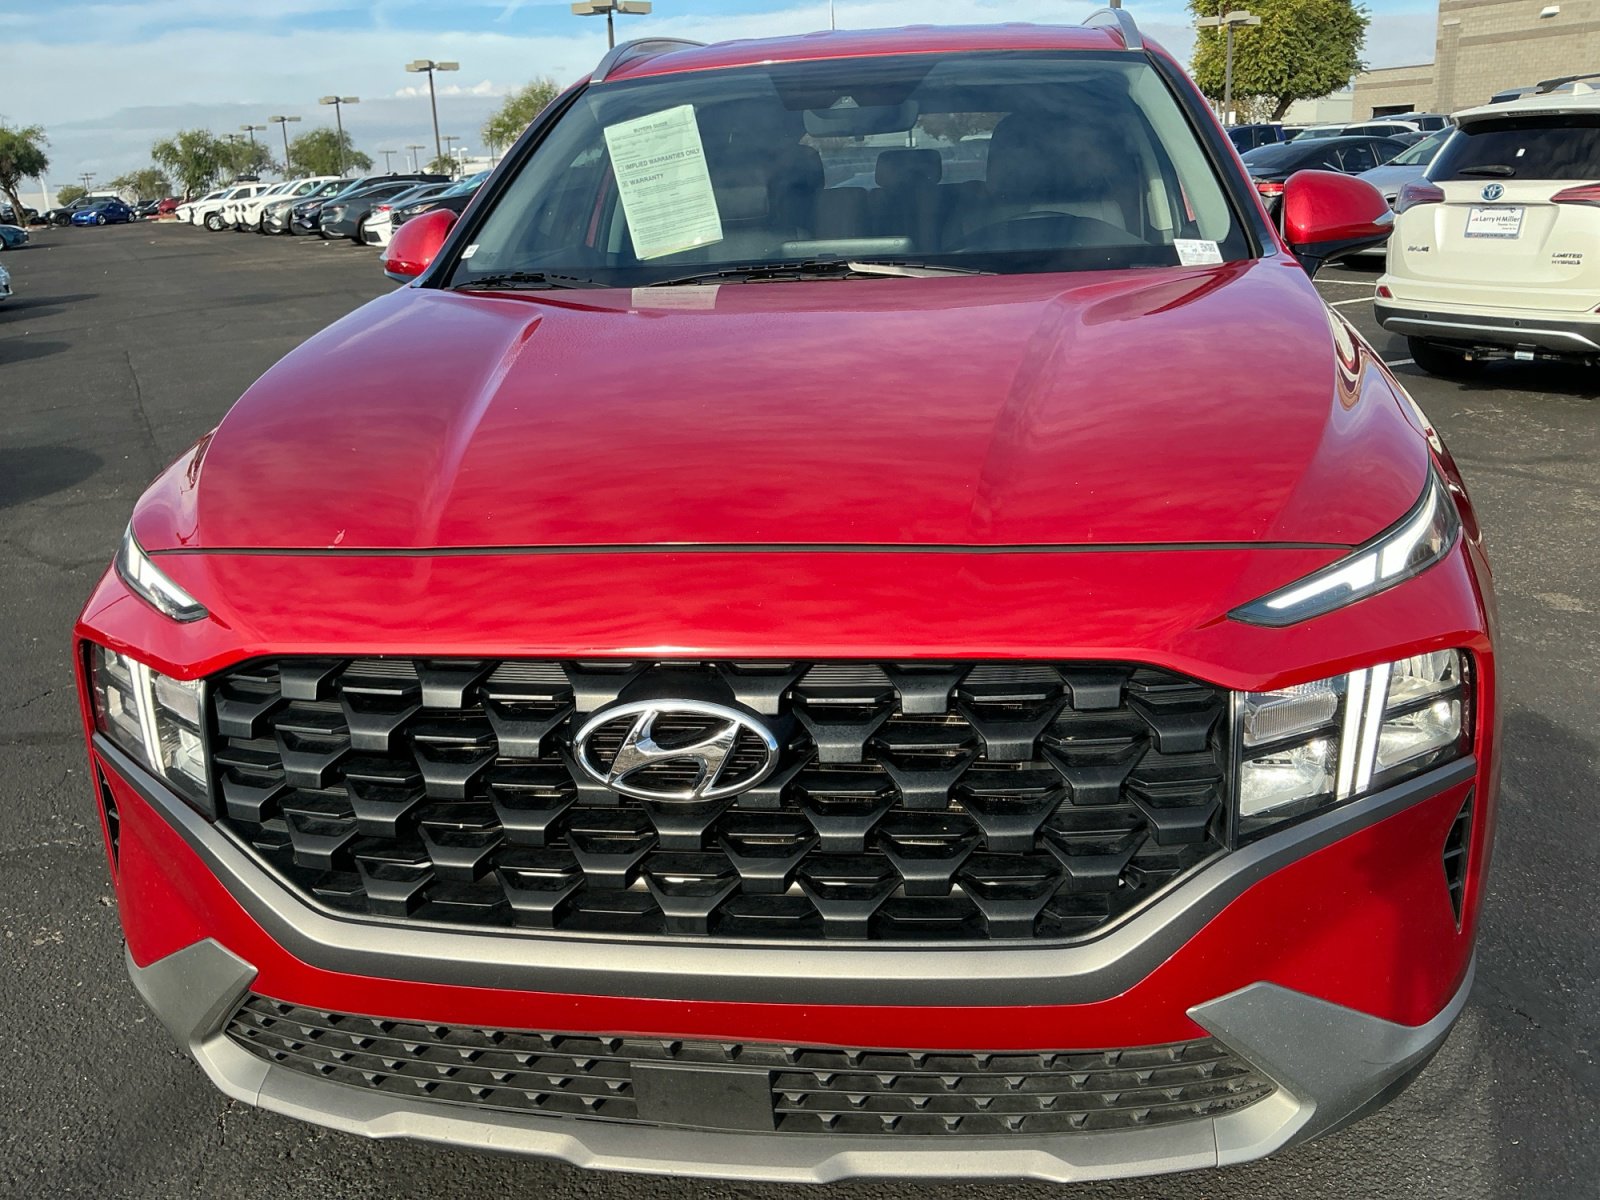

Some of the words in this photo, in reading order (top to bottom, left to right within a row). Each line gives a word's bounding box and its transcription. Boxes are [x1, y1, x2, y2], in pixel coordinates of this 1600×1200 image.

[625, 160, 648, 170] IMPLIED
[649, 151, 685, 164] WARRANTIES
[685, 148, 700, 156] ONLY
[629, 173, 664, 185] WARRANTY
